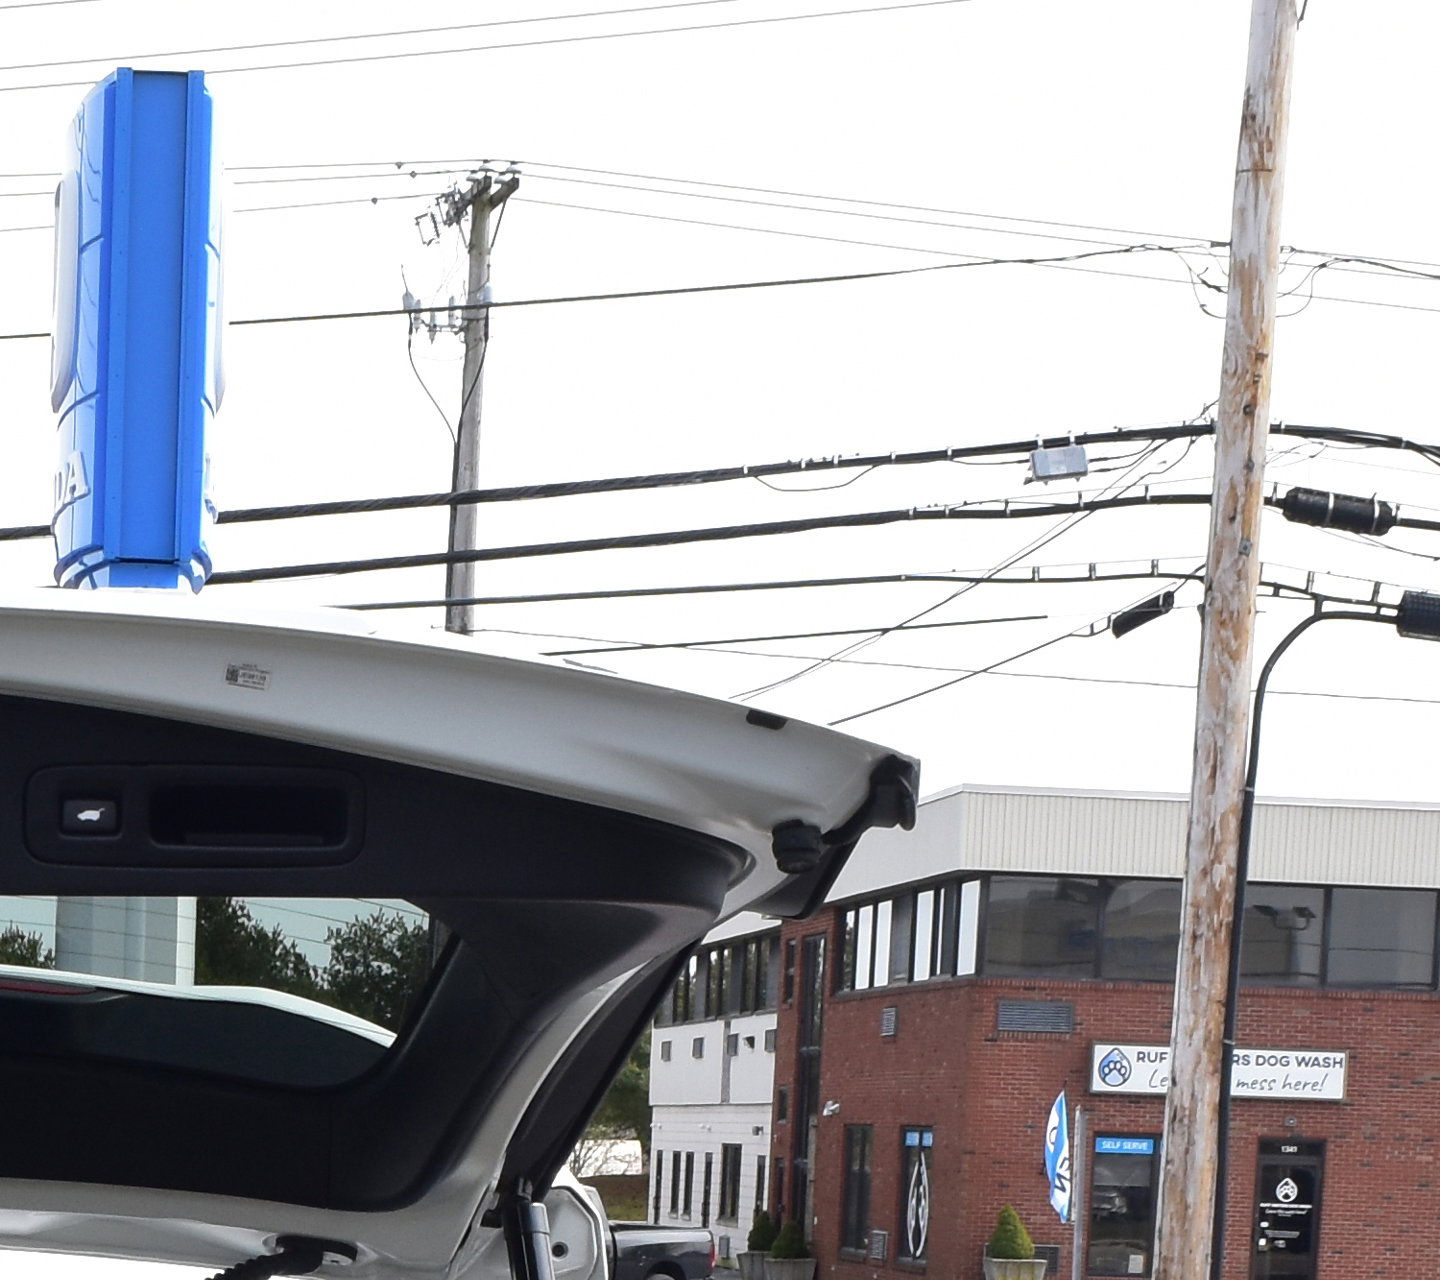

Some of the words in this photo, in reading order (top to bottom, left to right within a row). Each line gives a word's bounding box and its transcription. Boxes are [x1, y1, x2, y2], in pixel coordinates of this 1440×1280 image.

[1136, 1051, 1168, 1063] RUF
[1255, 1054, 1290, 1067] DOG
[1296, 1055, 1343, 1069] WASH
[1236, 1079, 1275, 1091] mess
[1282, 1074, 1328, 1092] here!
[1102, 1141, 1120, 1149] SELF
[1123, 1142, 1148, 1150] SERVE
